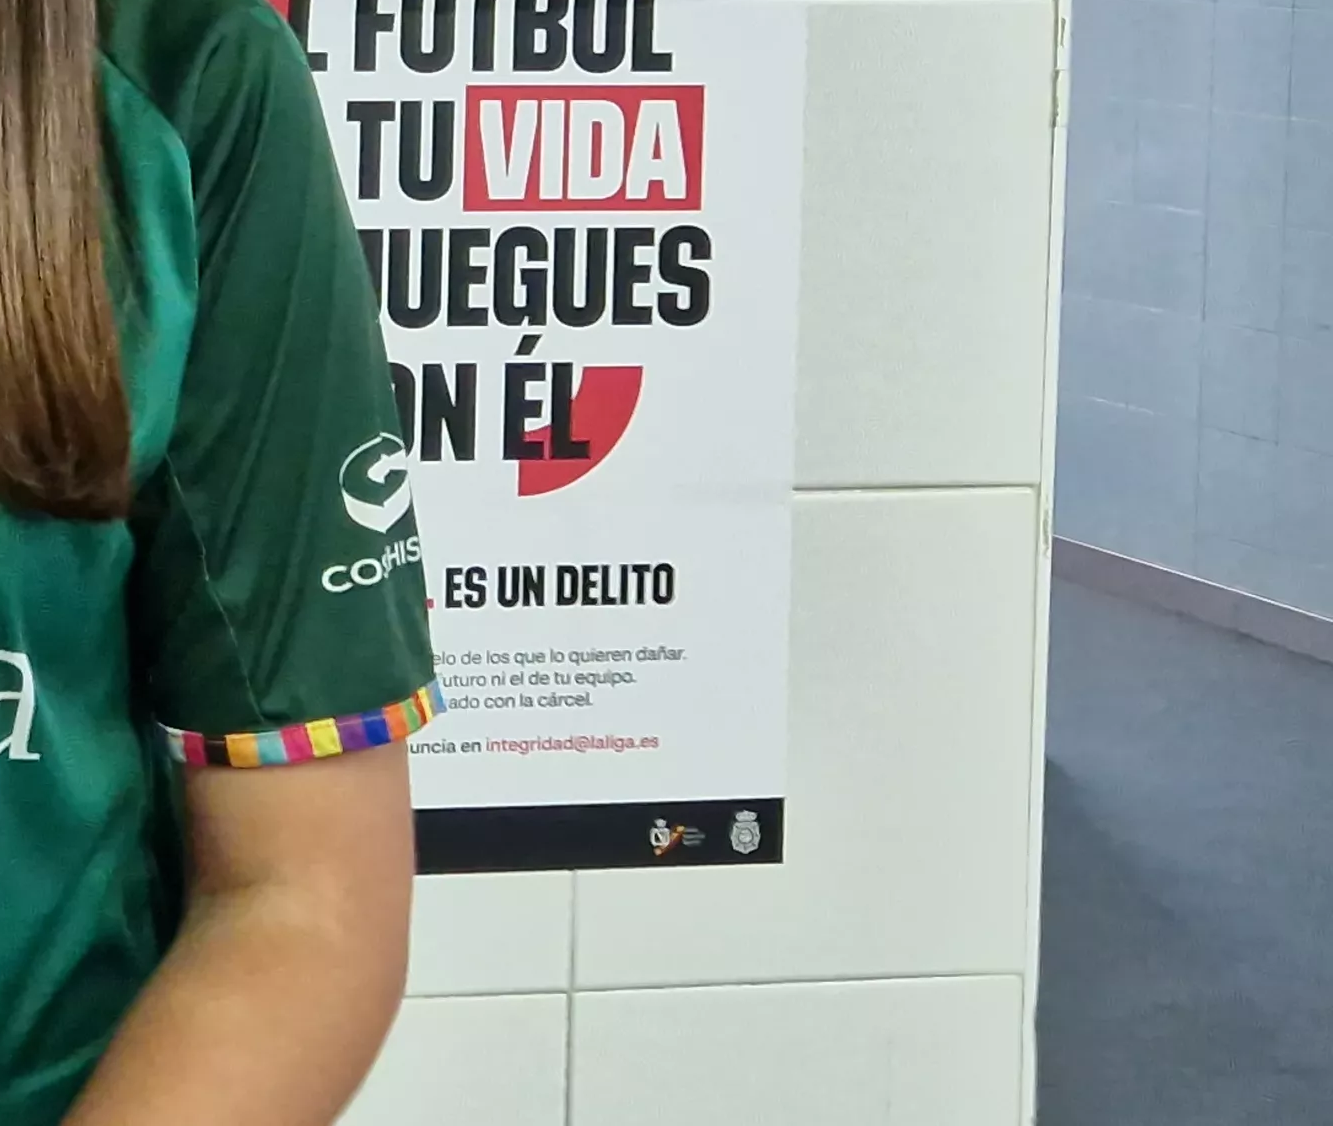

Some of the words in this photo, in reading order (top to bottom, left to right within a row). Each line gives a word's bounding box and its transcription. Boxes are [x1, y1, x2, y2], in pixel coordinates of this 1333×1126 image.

[346, 100, 454, 202] TU
[478, 98, 688, 202] VIDA
[503, 334, 590, 460] ÉL
[445, 566, 488, 609] ES
[497, 565, 545, 607] UN
[556, 563, 675, 606] DELITO
[461, 651, 482, 665] de
[486, 650, 511, 665] los
[514, 652, 546, 667] que
[550, 649, 565, 663] lo
[568, 648, 632, 666] quieren
[635, 646, 687, 661] dañar.
[491, 671, 506, 686] ni
[510, 671, 525, 685] el
[528, 671, 550, 685] de
[553, 671, 571, 685] tu
[574, 670, 637, 688] equipo.
[484, 696, 516, 708] con
[519, 692, 533, 707] la
[537, 692, 593, 707] cárcel.
[410, 739, 457, 754] uncia
[461, 739, 482, 753] en
[486, 734, 660, 755] integridad@laliga.es
